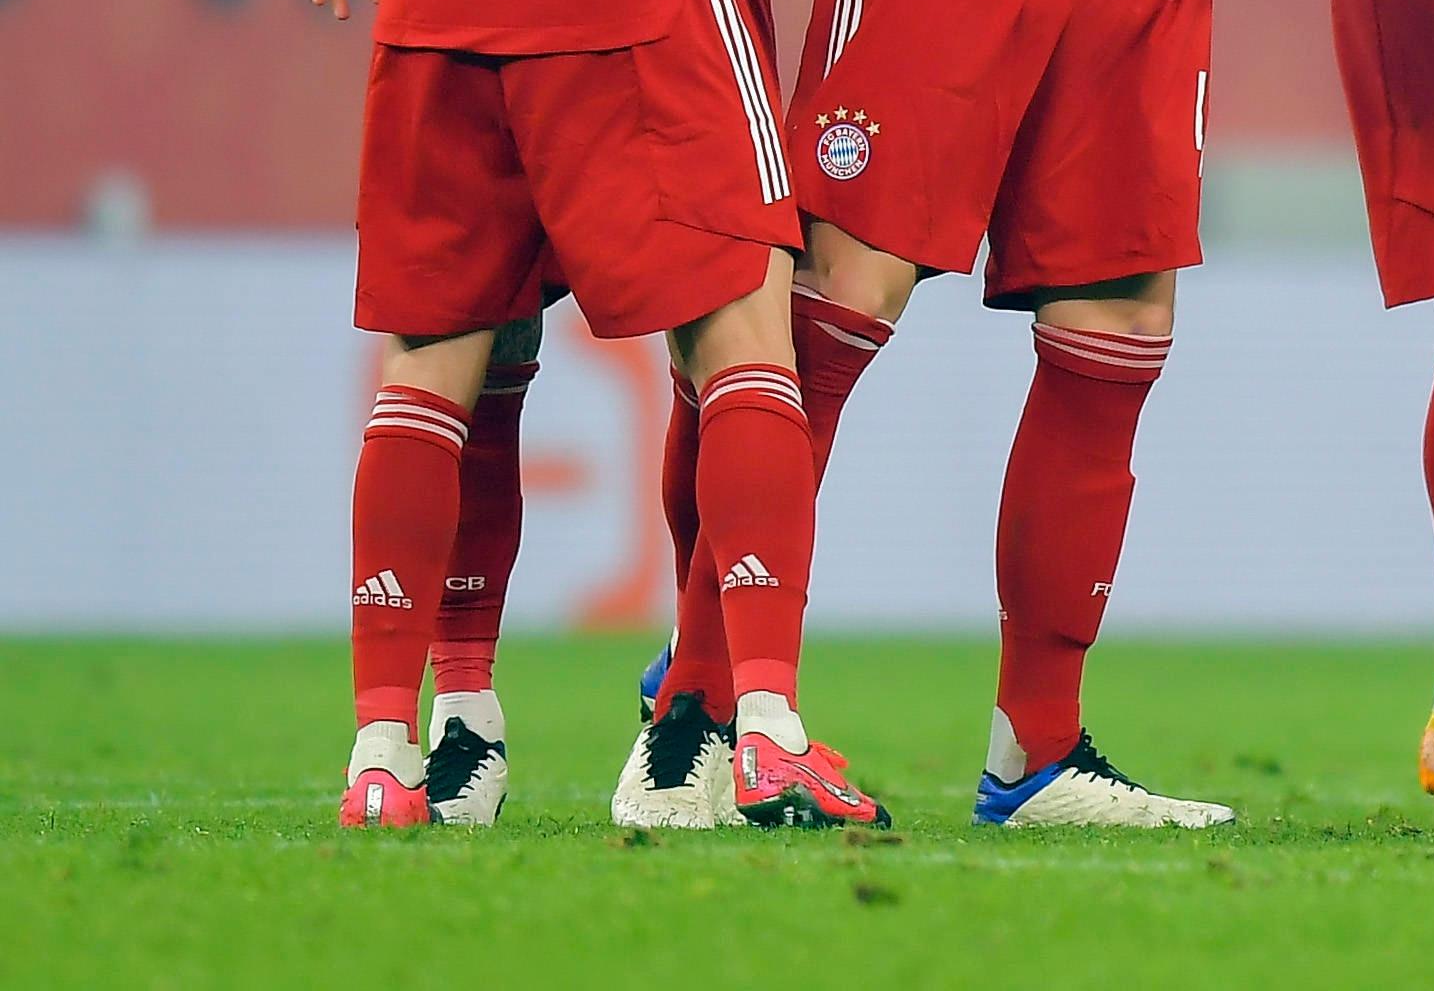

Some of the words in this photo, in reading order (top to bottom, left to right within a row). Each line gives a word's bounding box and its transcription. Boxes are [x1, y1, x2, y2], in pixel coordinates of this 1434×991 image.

[836, 128, 866, 151] BAYERN
[446, 577, 487, 591] CB
[353, 591, 414, 609] adidas
